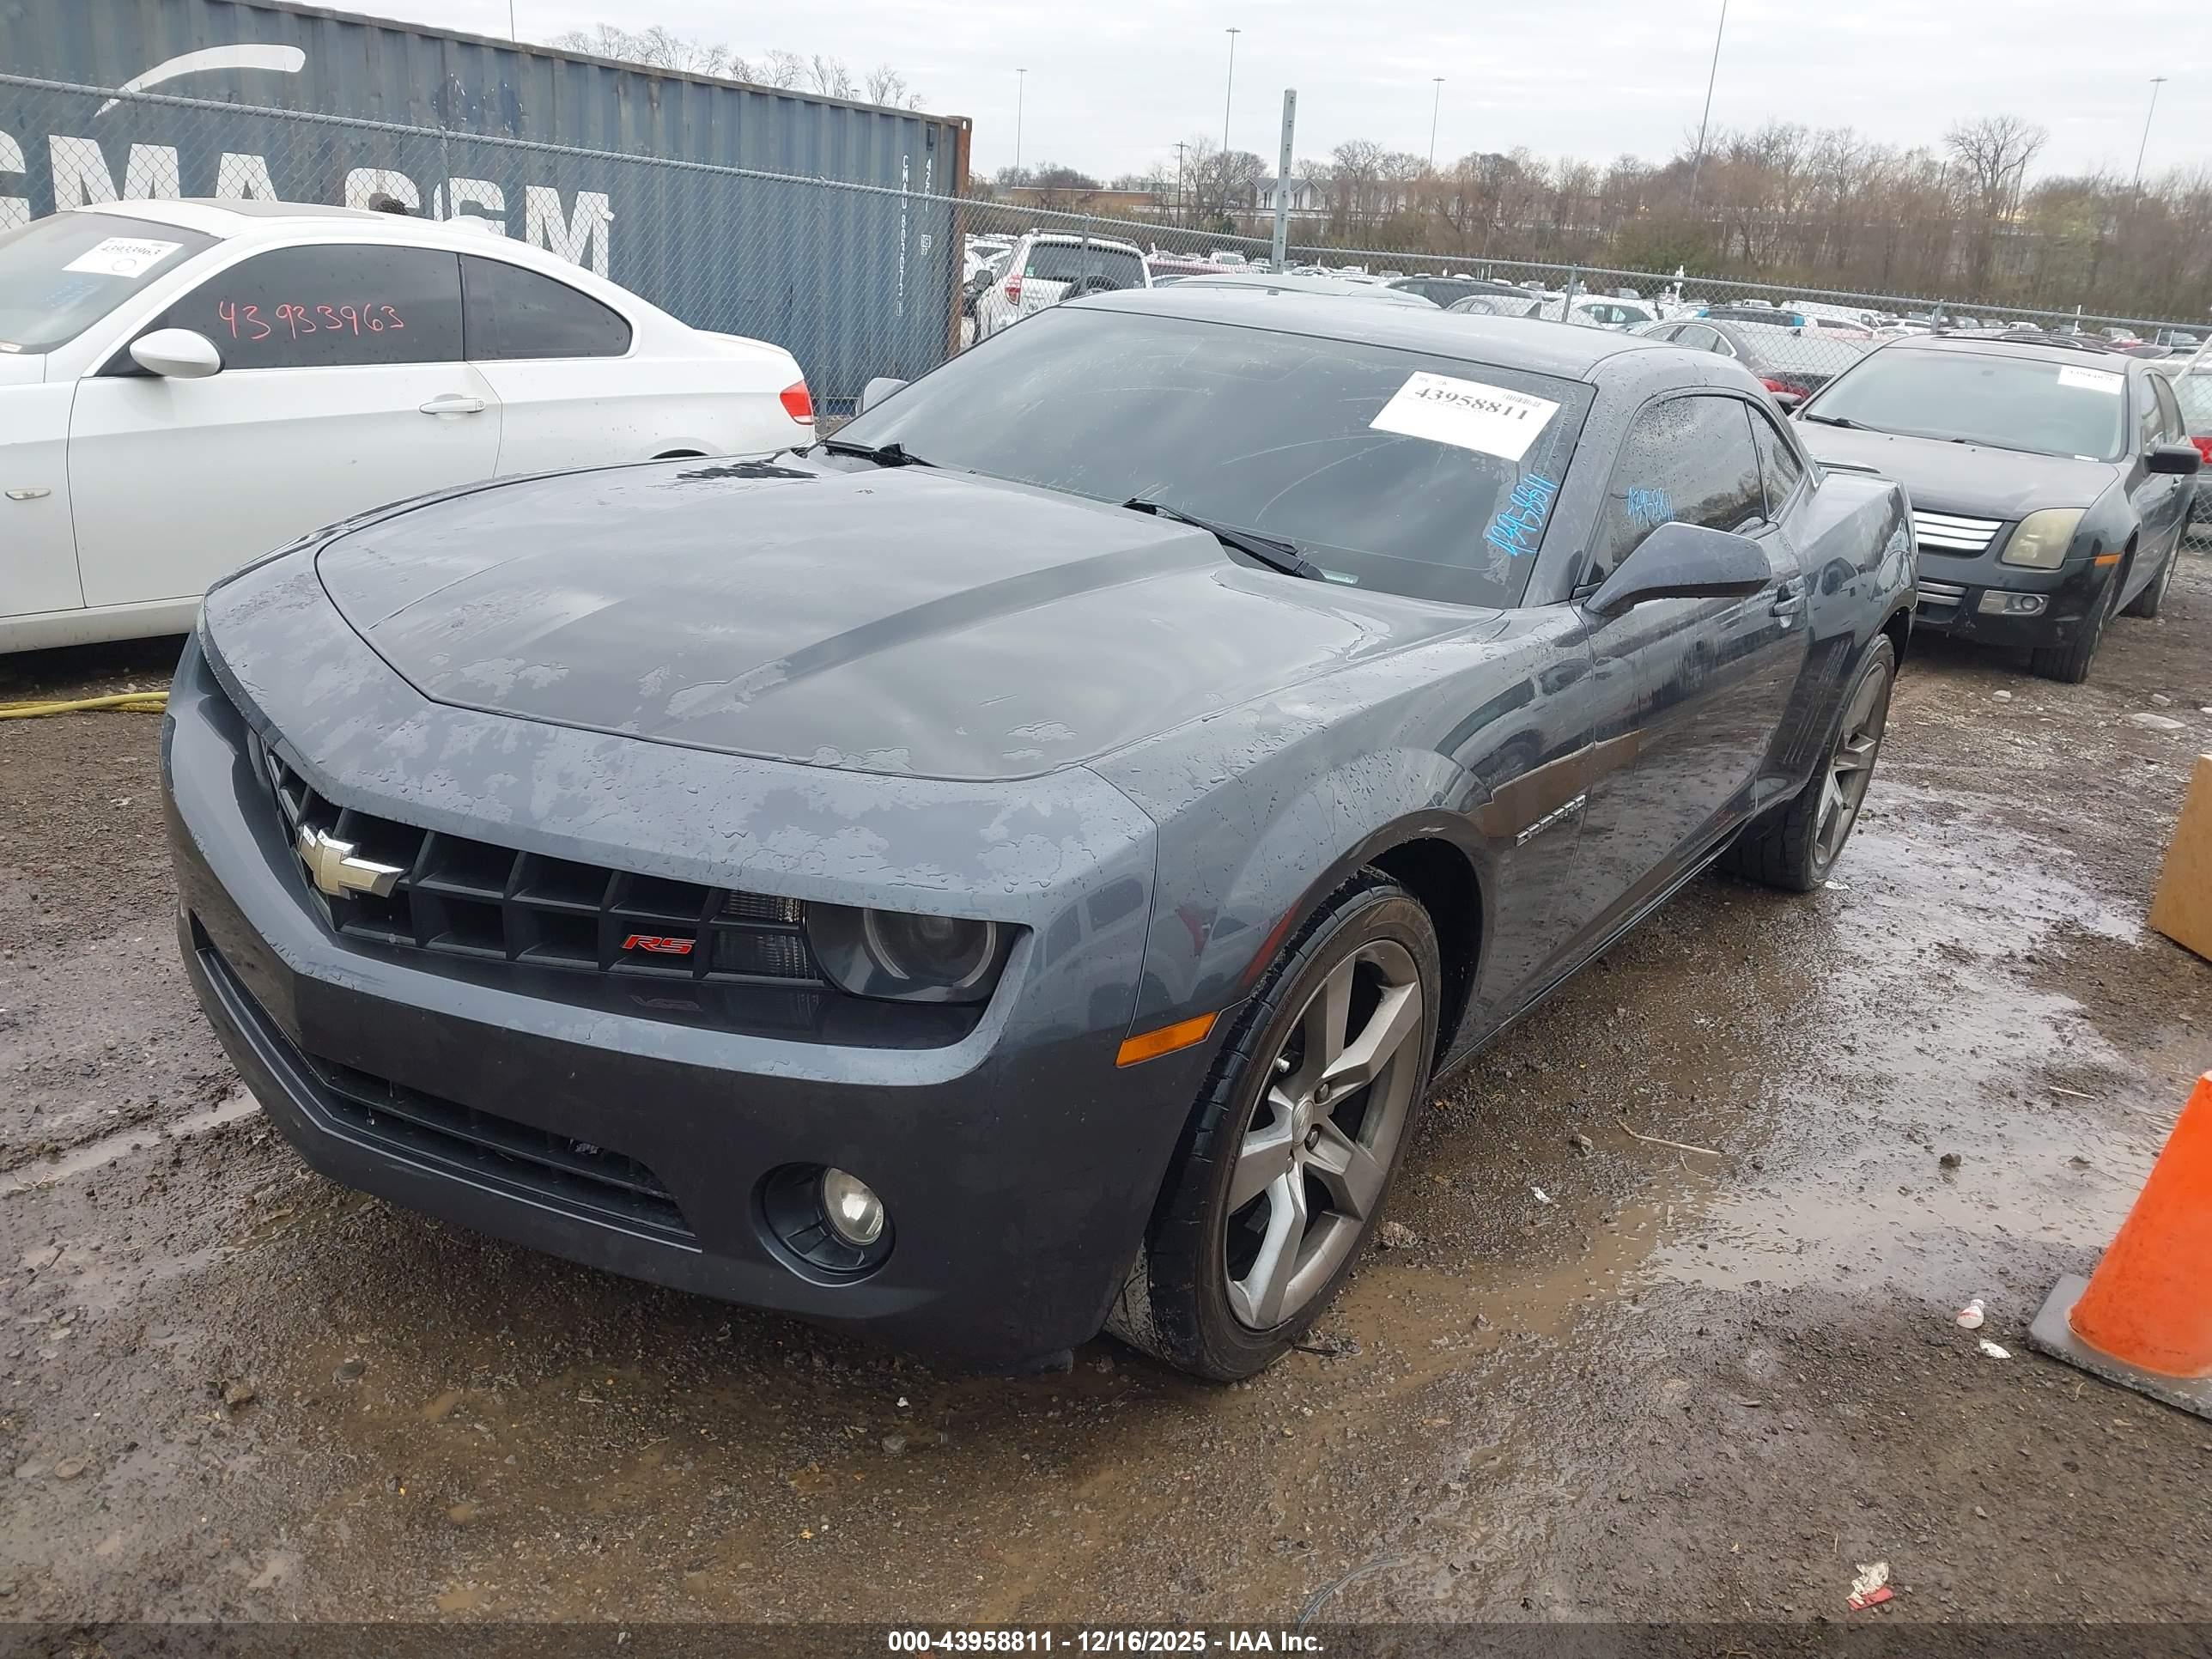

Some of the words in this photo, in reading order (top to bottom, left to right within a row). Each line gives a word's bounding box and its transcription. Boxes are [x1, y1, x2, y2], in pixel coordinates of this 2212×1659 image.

[218, 301, 404, 339] 43933963
[1415, 387, 1528, 421] 43958811
[622, 934, 696, 954] RS
